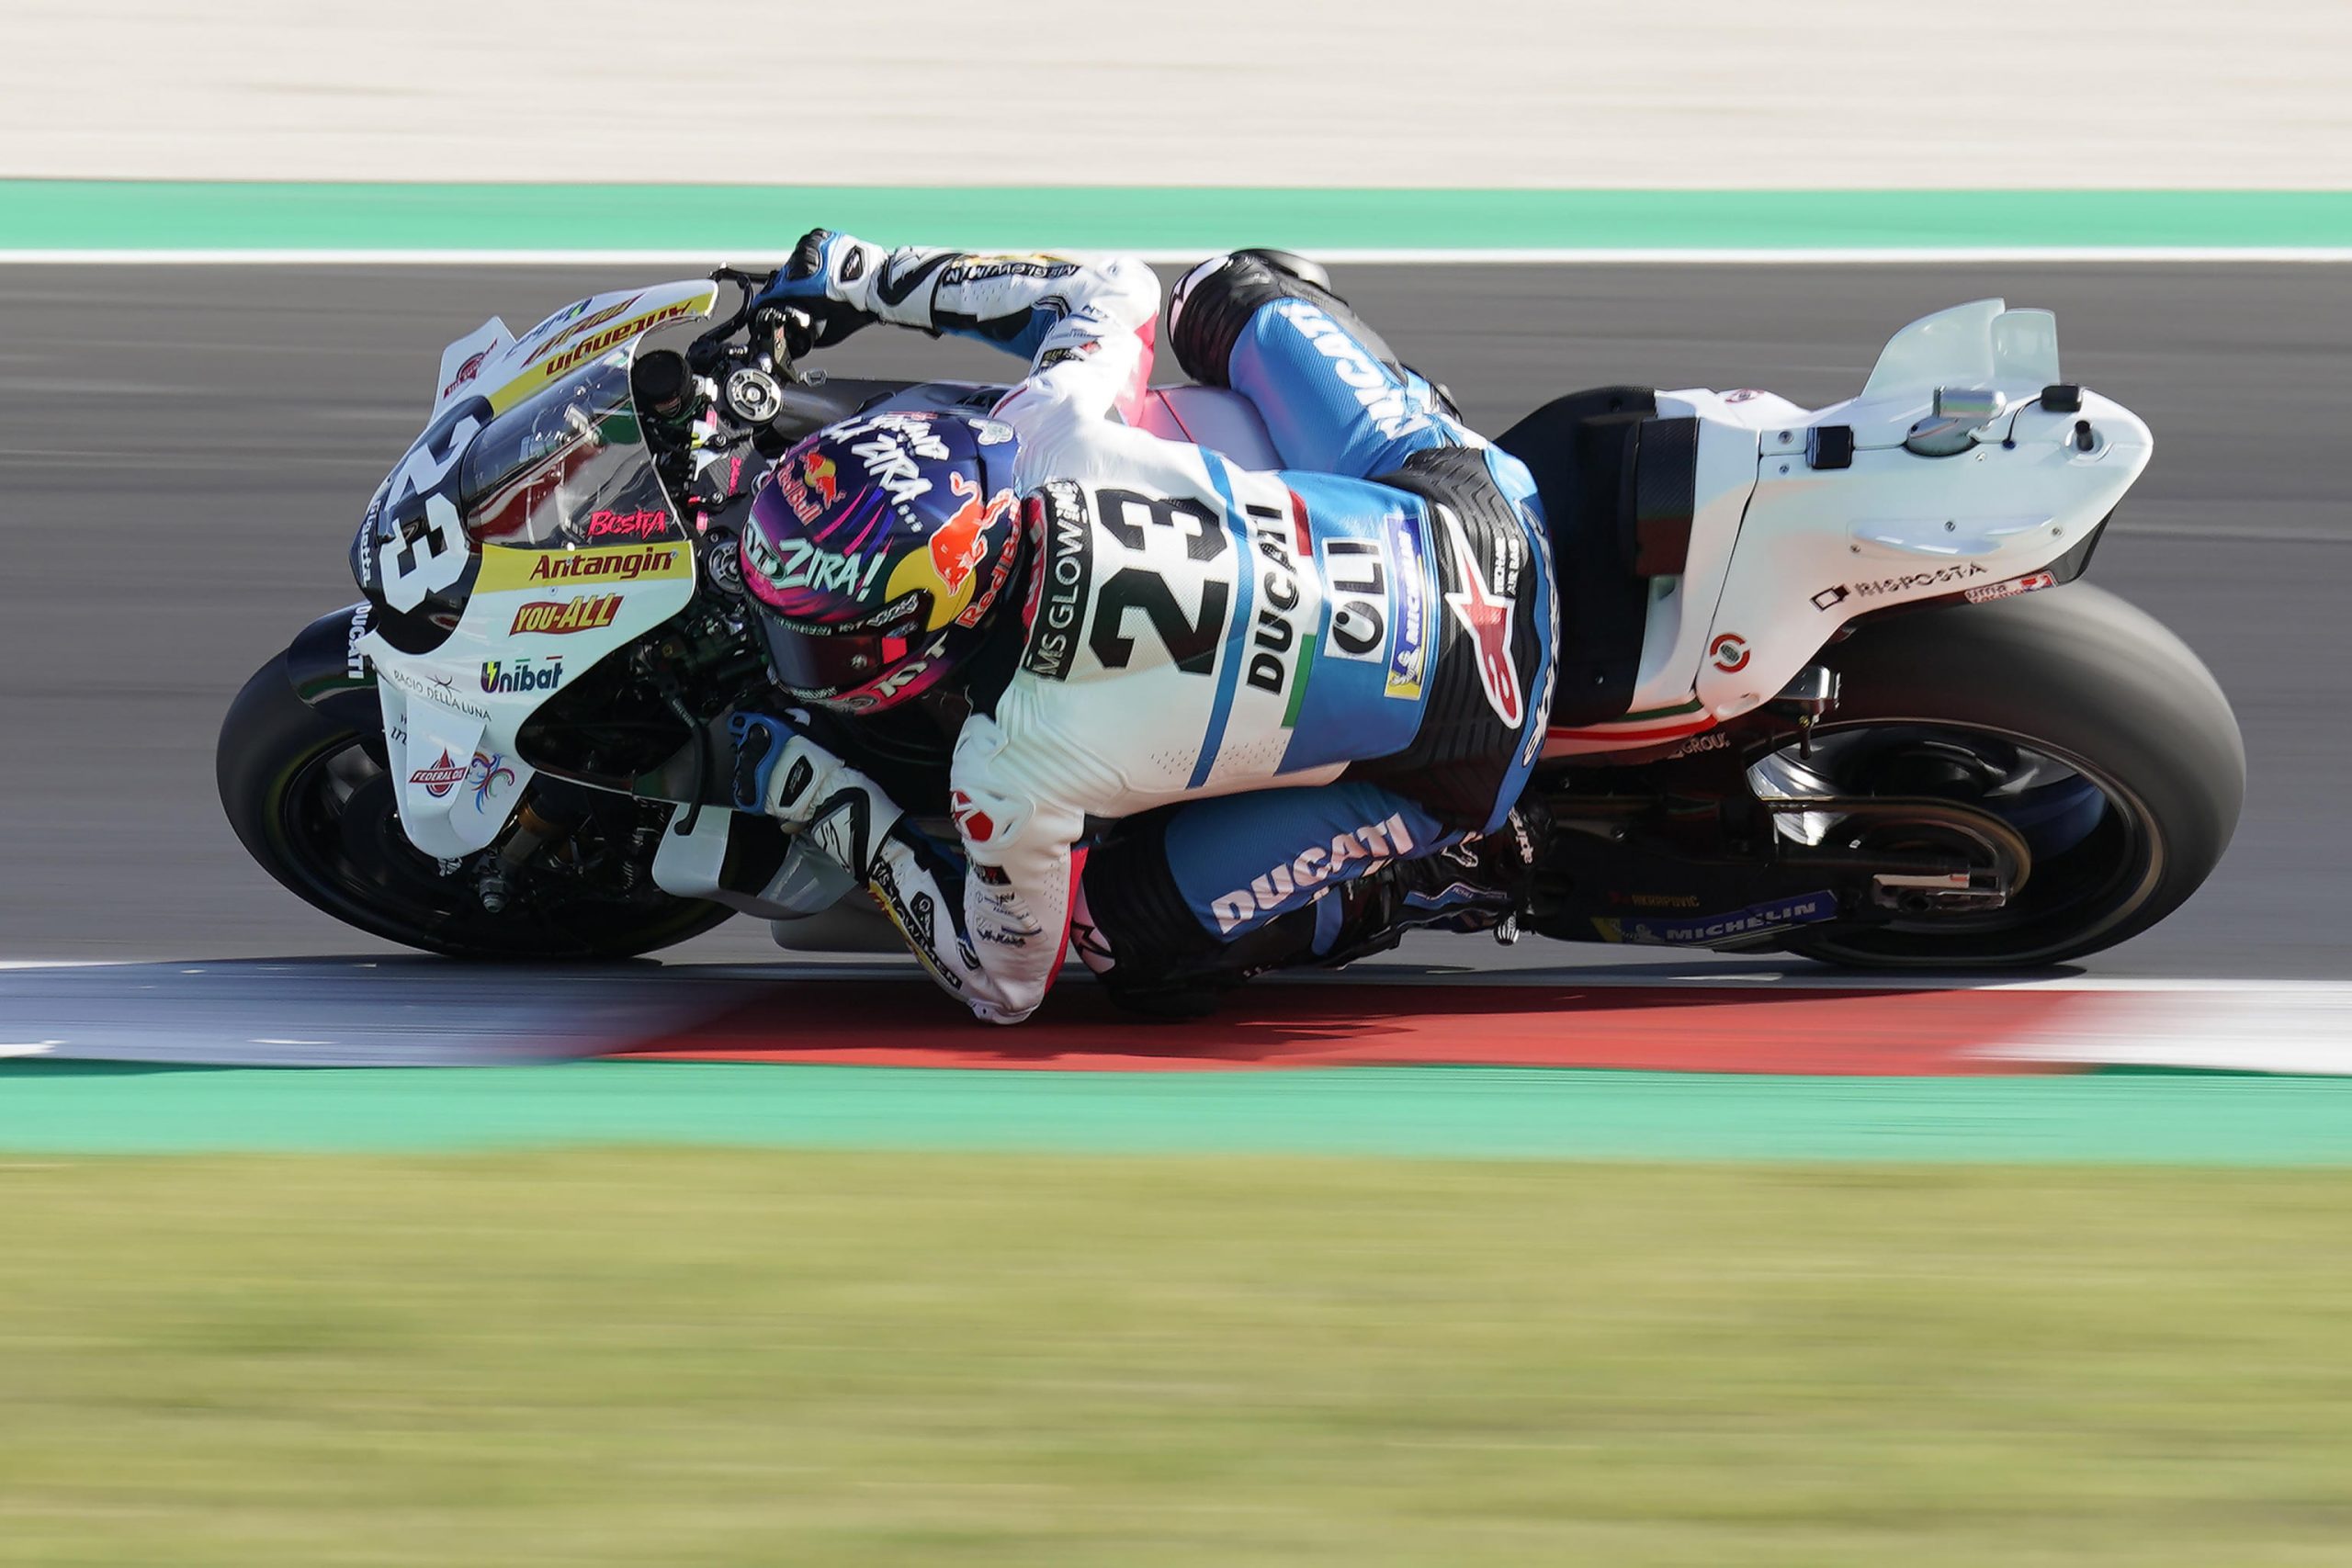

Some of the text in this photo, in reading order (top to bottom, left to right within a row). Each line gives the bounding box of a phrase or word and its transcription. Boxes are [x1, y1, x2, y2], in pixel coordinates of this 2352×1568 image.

[379, 412, 482, 614] 23
[529, 547, 673, 581] Antangin
[1048, 518, 1084, 629] GLOW
[1089, 489, 1229, 676] 23
[1853, 561, 1988, 597] RISPOSTA
[514, 592, 616, 633] YOU-ALL
[1032, 632, 1067, 676] MS
[481, 660, 563, 694] Unibat
[427, 687, 460, 711] DELLA
[461, 699, 492, 723] LUNA
[1682, 732, 1731, 754] GROU
[413, 769, 452, 782] FEDERAL
[1211, 812, 1415, 935] DUCATI
[1667, 902, 1816, 941] MICHELIN
